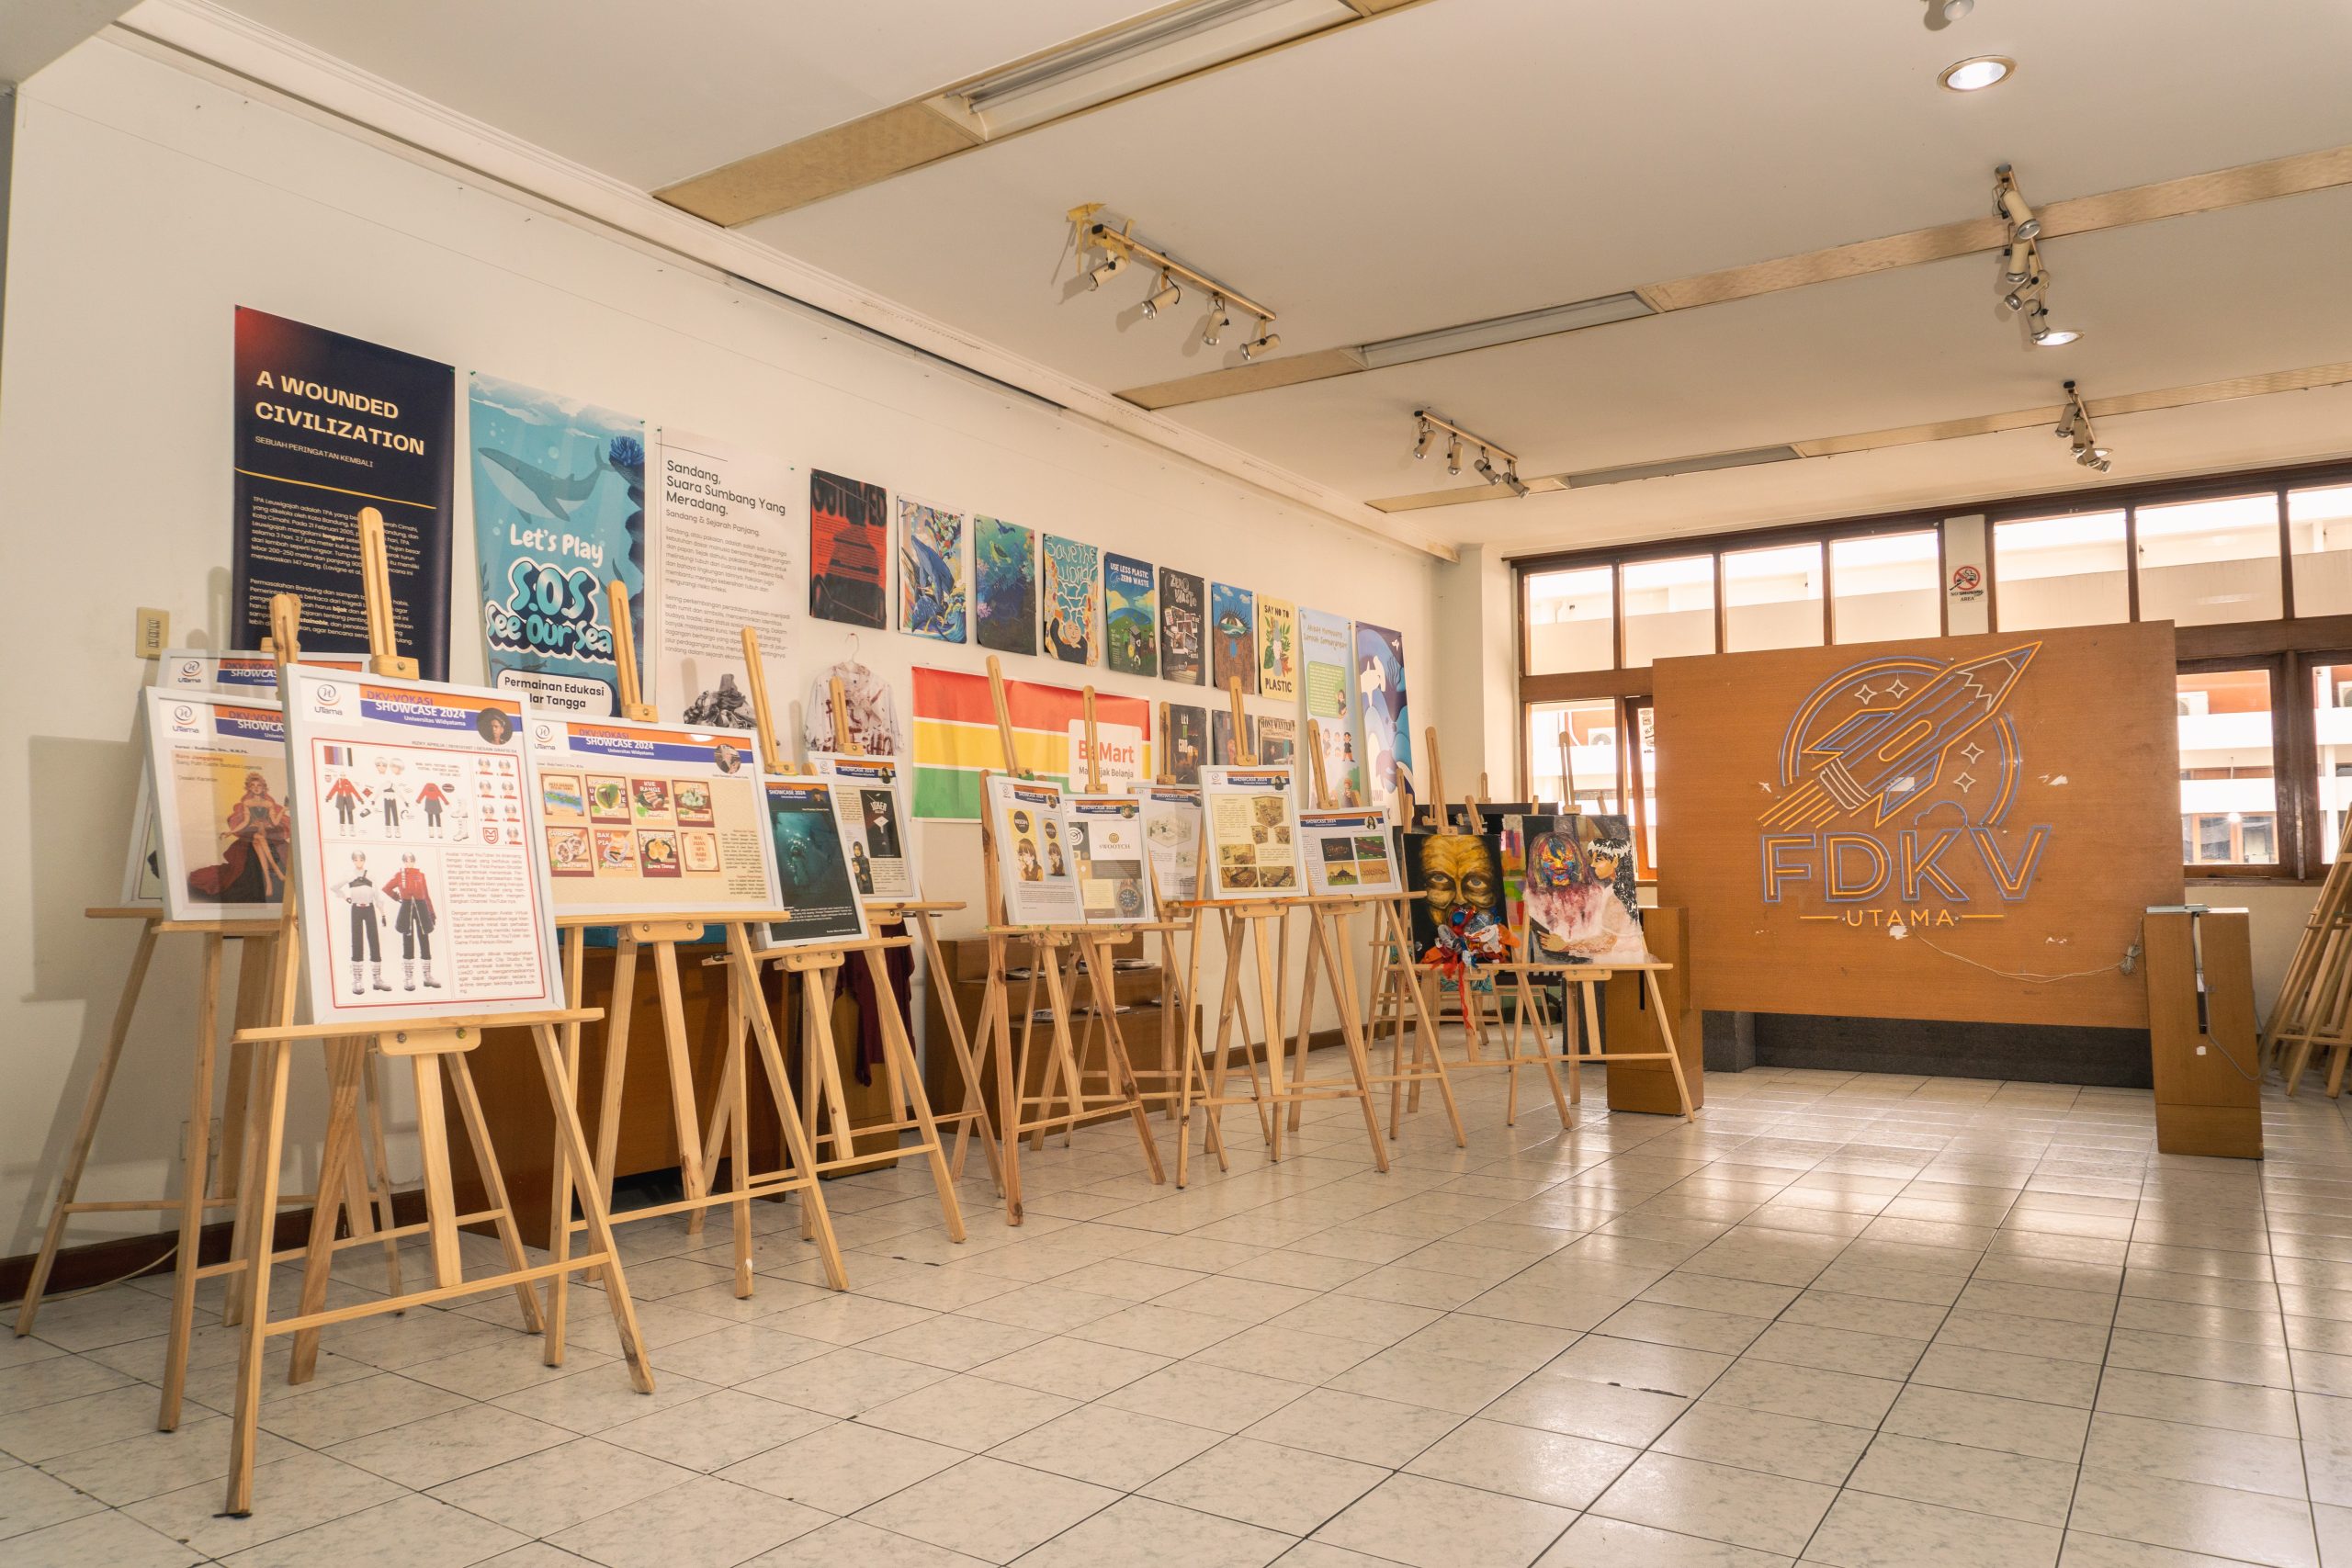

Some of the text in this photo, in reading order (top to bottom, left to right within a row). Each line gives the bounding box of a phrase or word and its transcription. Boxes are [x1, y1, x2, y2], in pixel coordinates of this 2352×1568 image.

[257, 371, 398, 419] A WOUNDED
[255, 401, 424, 456] CIVILIZATION
[255, 436, 373, 468] SEBUAH PERINGATAN KEMBALI
[667, 460, 720, 485] Sandang,
[667, 476, 786, 515] Suara Sumbang Yang
[667, 491, 728, 516] Meradang.
[666, 510, 697, 523] Sandang
[707, 518, 731, 529] Sejarah
[510, 524, 603, 568] Let's Play
[1111, 563, 1148, 579] USE LESS PLASTIC
[1121, 574, 1132, 583] ZERO
[1133, 577, 1149, 587] WASTE
[1264, 605, 1289, 618] SAY NO TO
[488, 606, 612, 654] See Our Sea
[505, 677, 605, 695] Permainan Edukasi
[1265, 678, 1292, 693] PLASTIC
[376, 702, 466, 719] SHOWCASE 2024
[530, 694, 586, 710] lar Tangga
[404, 716, 466, 727] Universitas Widyatama
[586, 737, 653, 750] SHOWCASE 2024
[1112, 769, 1133, 779] Belanja
[1762, 825, 2052, 902] FDKV
[1846, 909, 1956, 927] UTAMA
